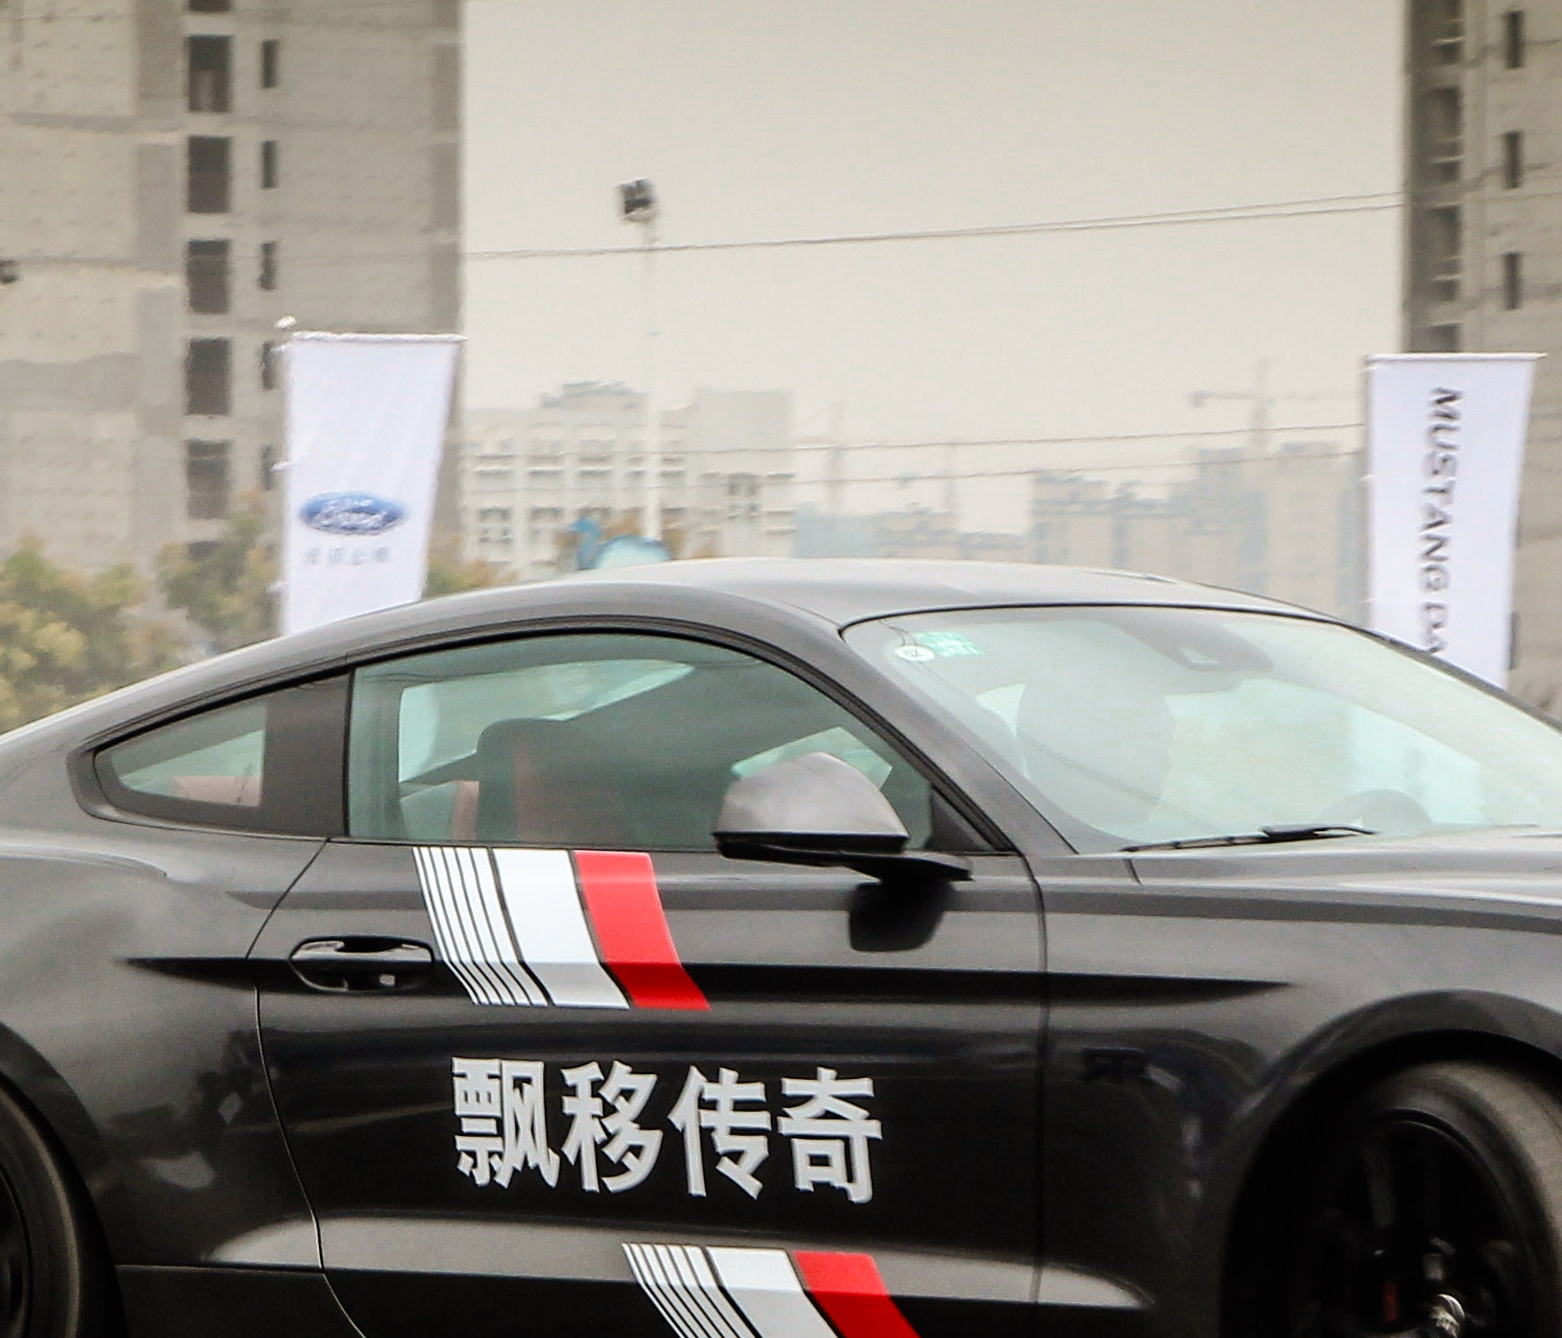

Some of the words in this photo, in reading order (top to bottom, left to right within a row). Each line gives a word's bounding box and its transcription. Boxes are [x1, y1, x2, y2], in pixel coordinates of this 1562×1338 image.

[1419, 386, 1463, 592] MUSTANG
[452, 1056, 882, 1204] 飘移传奇
